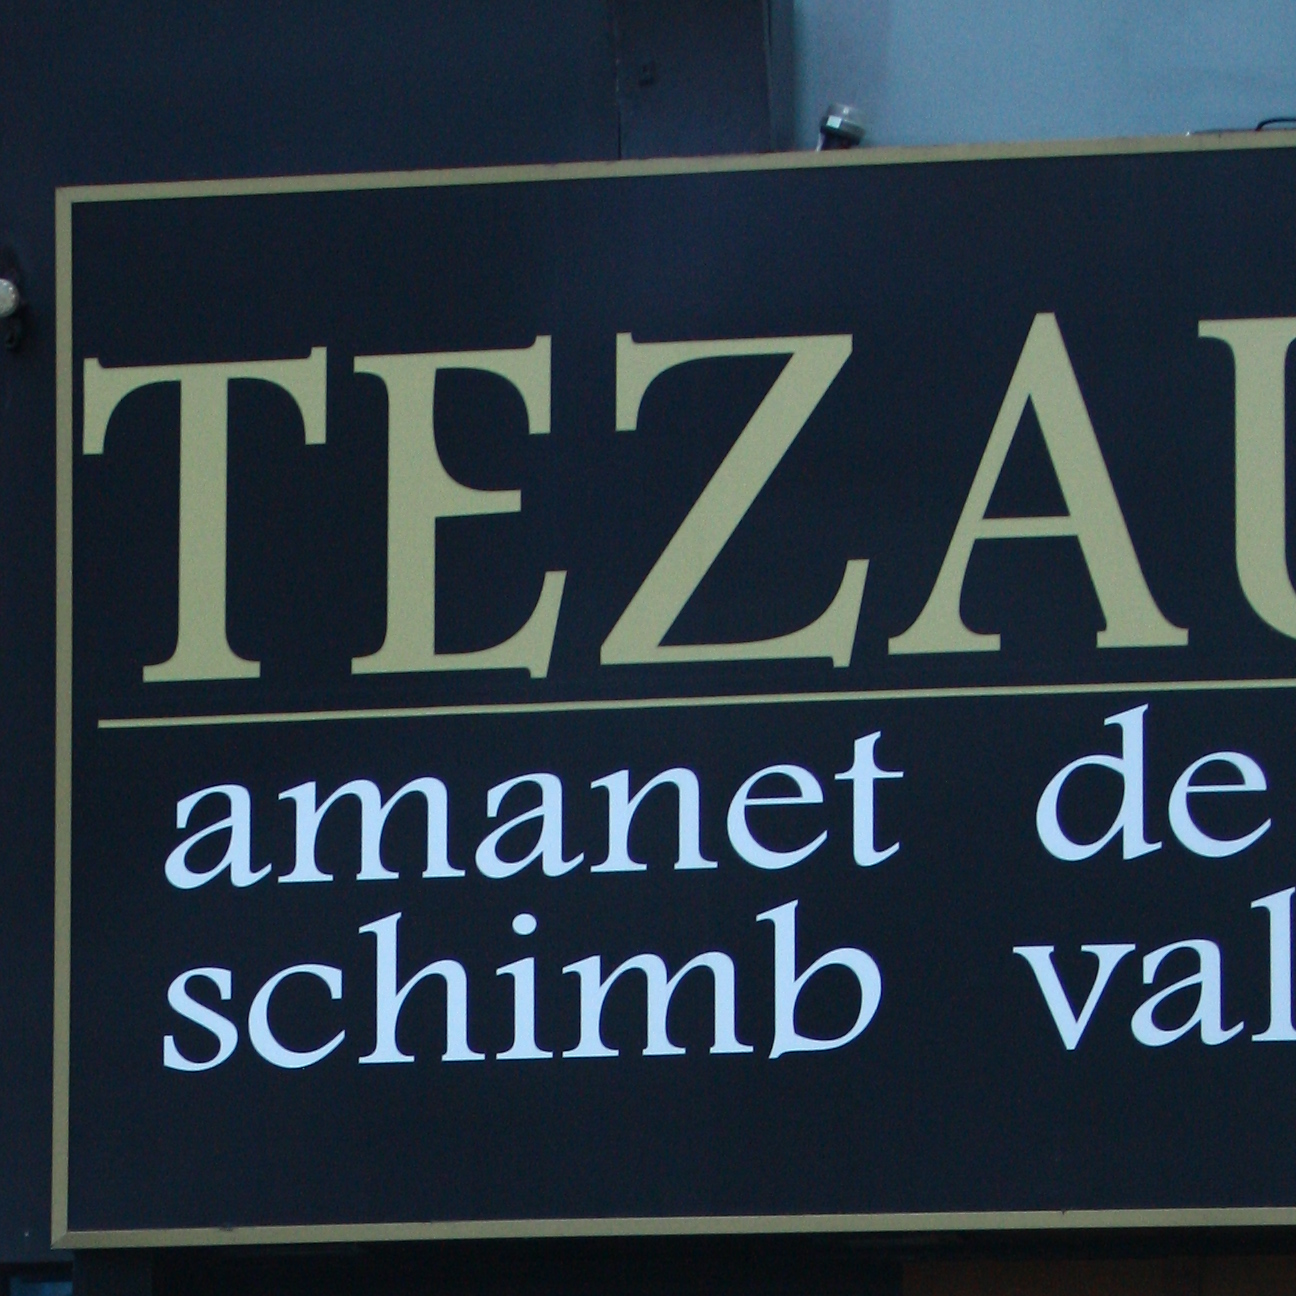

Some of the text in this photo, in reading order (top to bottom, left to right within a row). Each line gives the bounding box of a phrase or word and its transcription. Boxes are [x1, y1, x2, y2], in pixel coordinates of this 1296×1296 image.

[163, 703, 1272, 890] amanet de
[162, 886, 1296, 1072] schimb val
